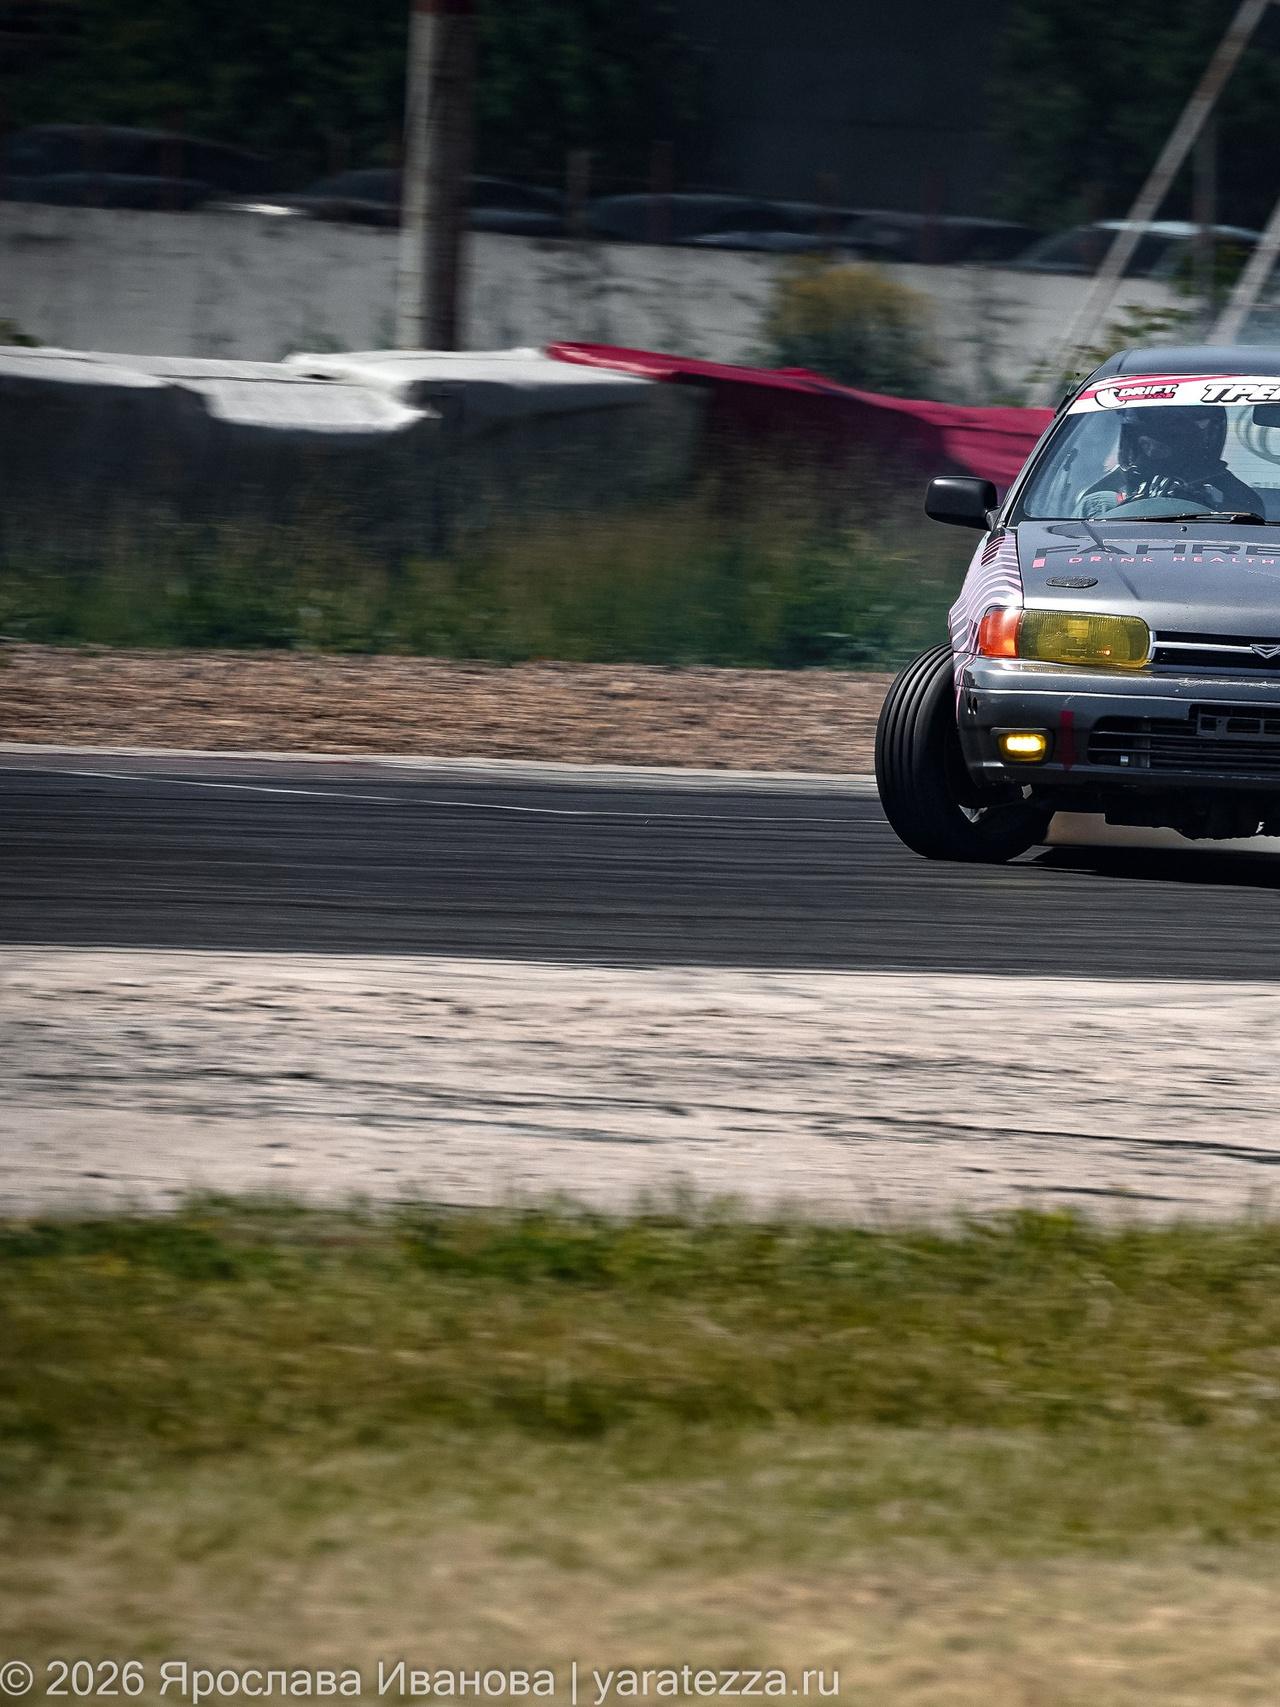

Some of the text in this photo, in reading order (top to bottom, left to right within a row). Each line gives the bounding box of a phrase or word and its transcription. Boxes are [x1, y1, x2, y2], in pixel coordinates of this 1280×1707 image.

[1118, 384, 1179, 396] DRIFT
[1068, 556, 1276, 565] DRINK HEALTH
